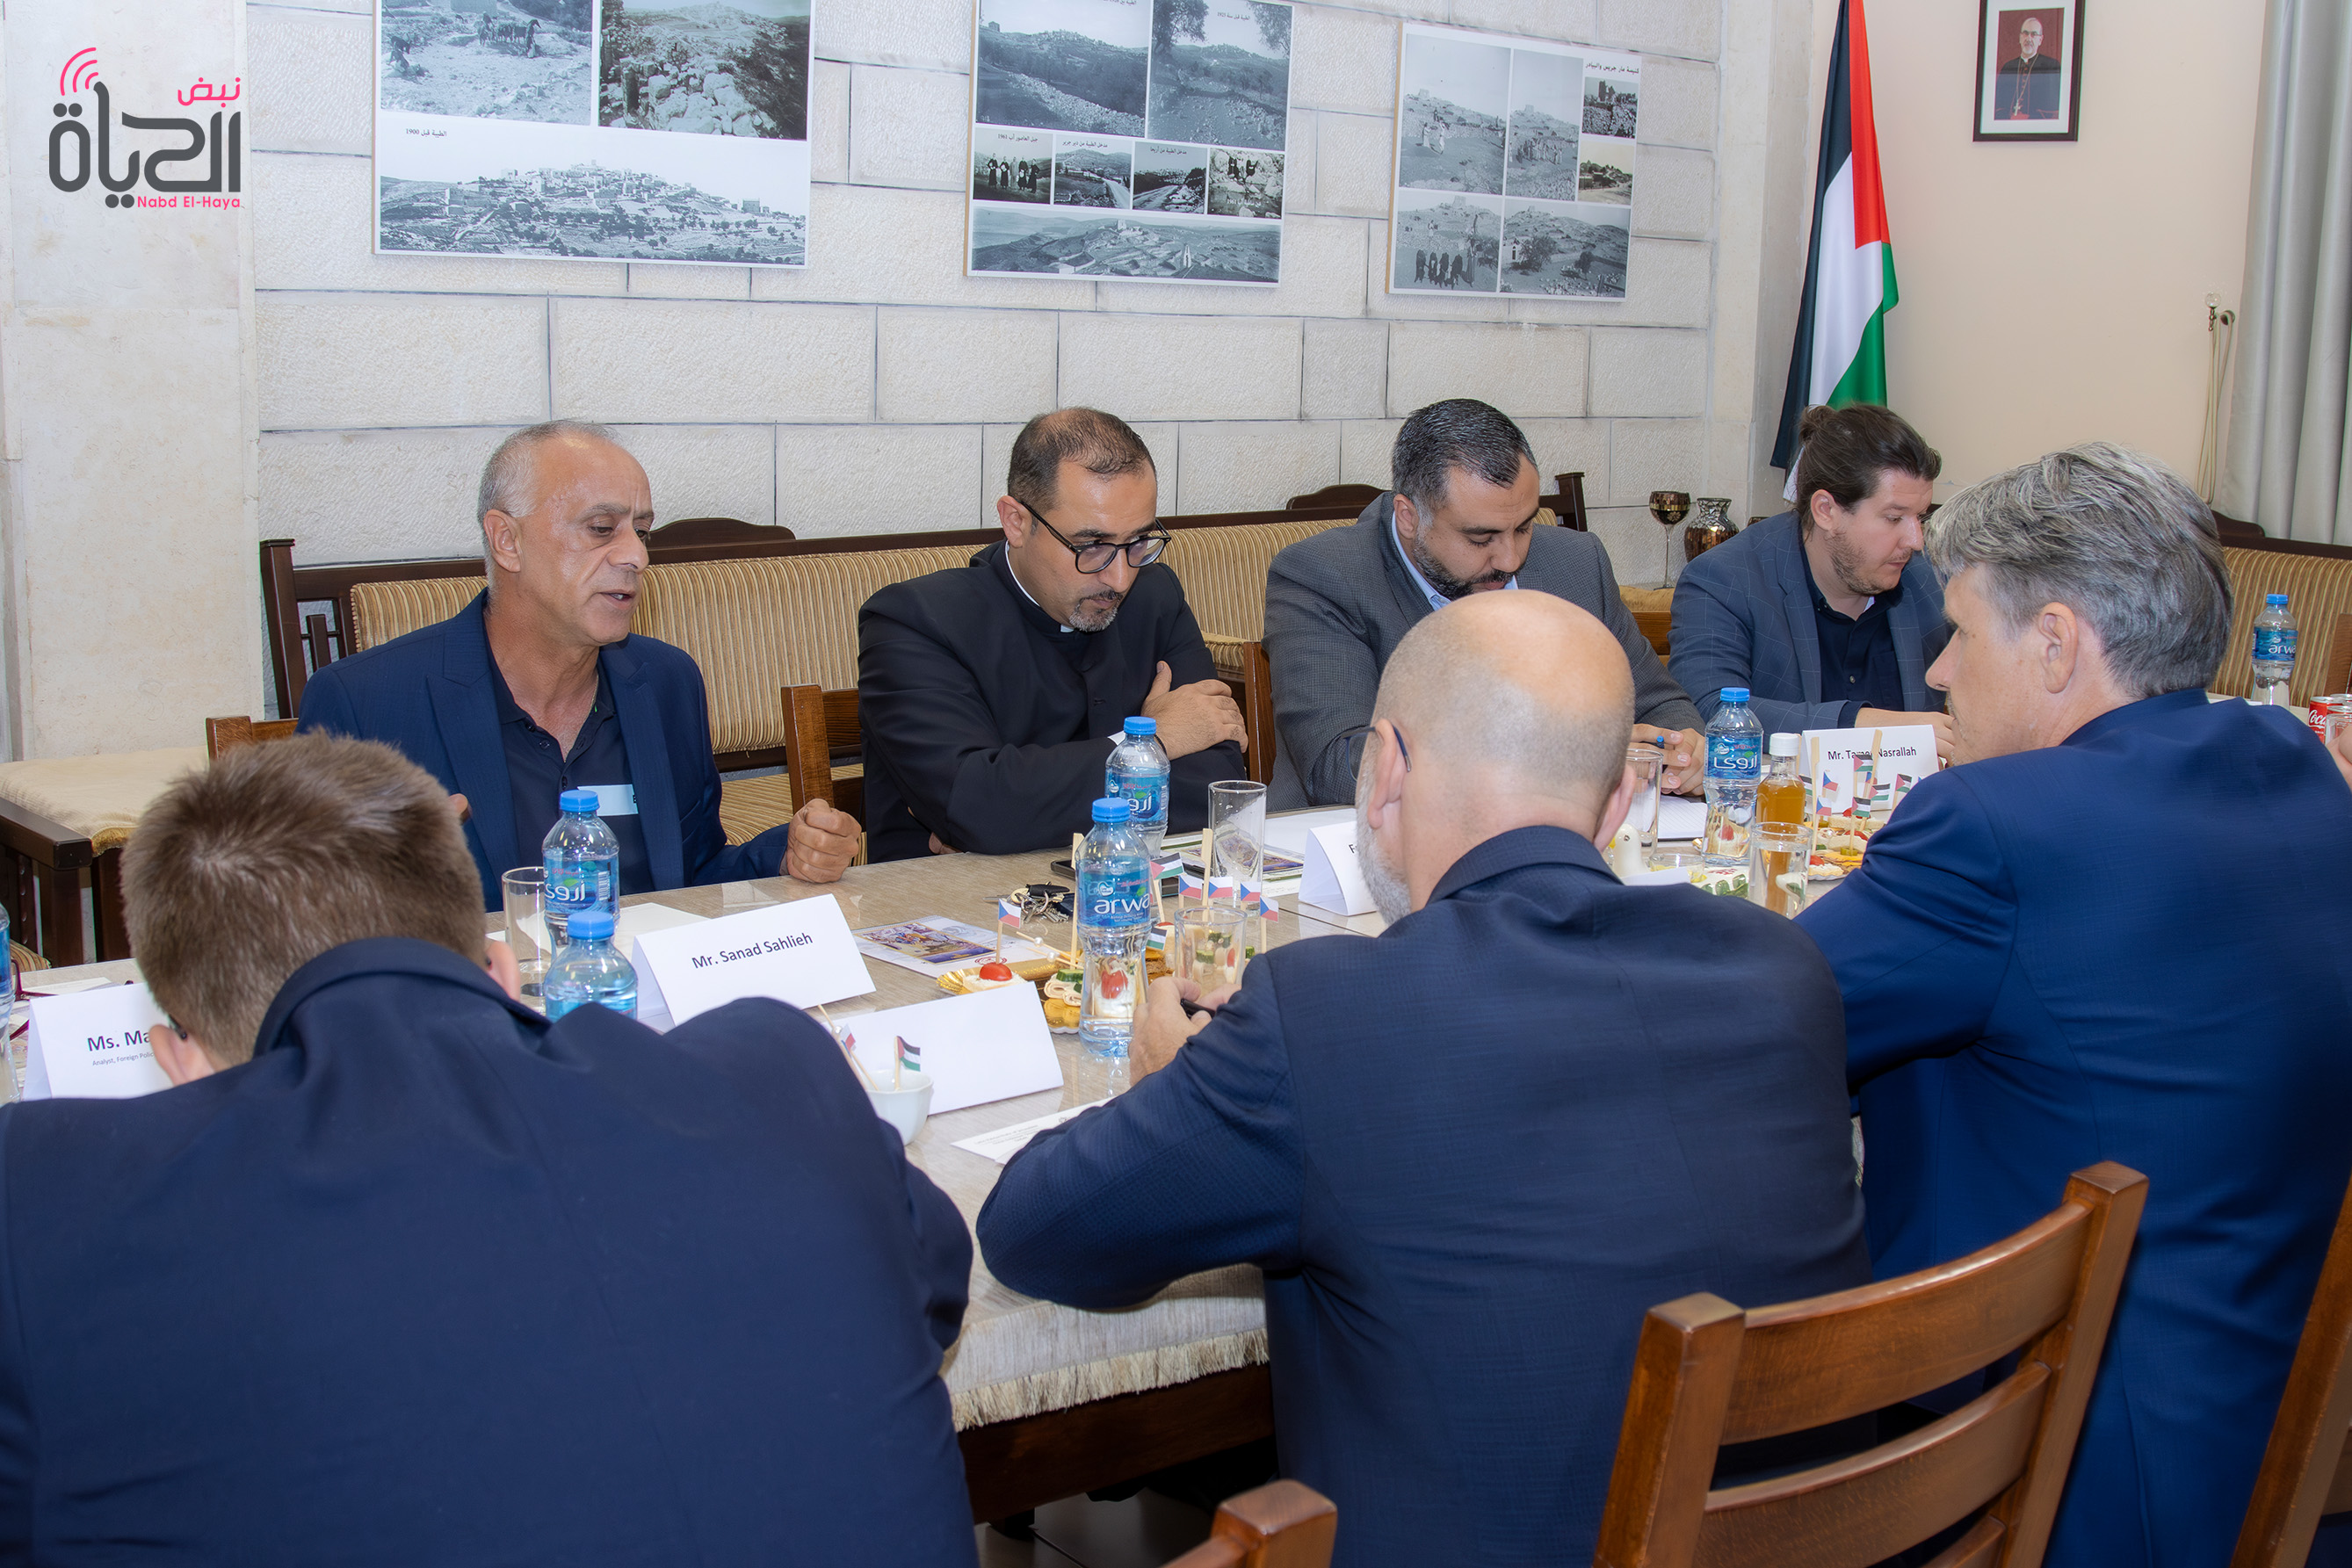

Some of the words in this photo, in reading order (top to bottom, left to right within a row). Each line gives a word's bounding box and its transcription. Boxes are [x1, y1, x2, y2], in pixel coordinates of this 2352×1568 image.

[431, 129, 447, 138] الطيبة
[2309, 709, 2327, 725] Coca
[1713, 752, 1757, 769] أروى
[1827, 750, 1844, 760] Mr.
[1879, 747, 1917, 757] Nasrallah
[1127, 792, 1152, 812] أرو
[1094, 892, 1150, 914] arwa
[691, 955, 719, 969] Mr.
[720, 943, 763, 963] Sanad
[763, 932, 814, 953] Sahlieh
[87, 1036, 120, 1051] Ms.
[117, 1054, 139, 1063] Foreign
